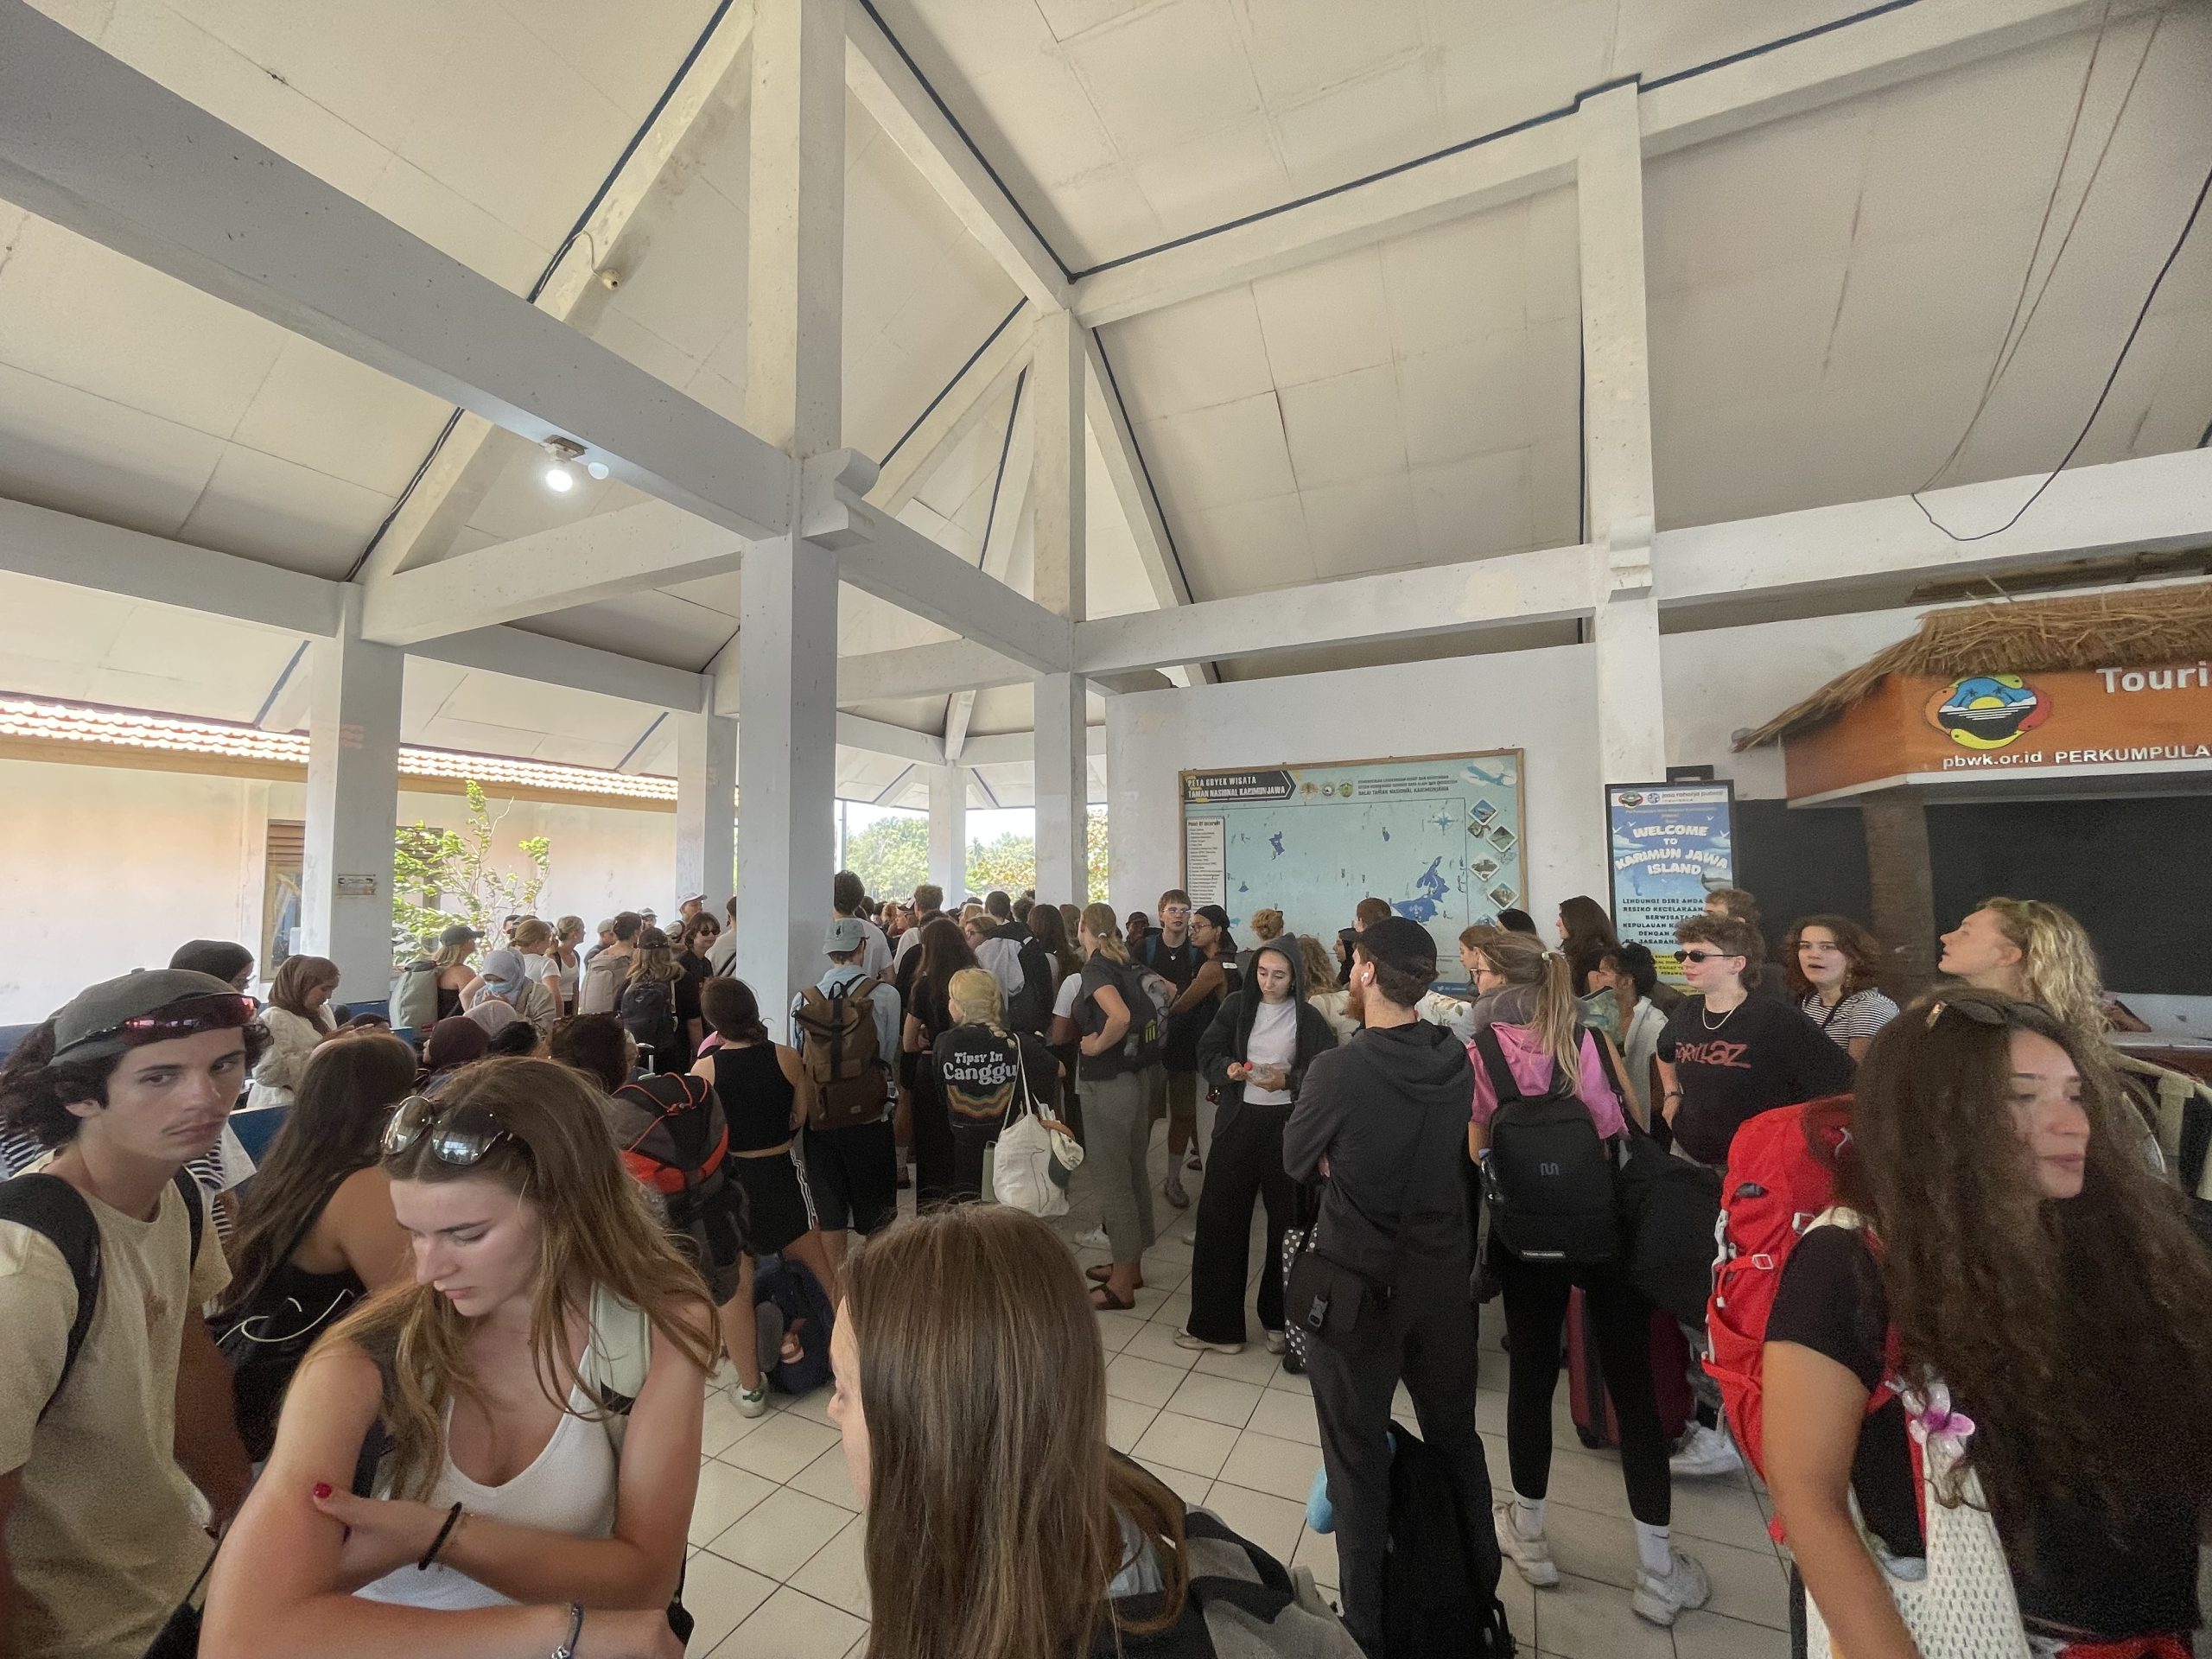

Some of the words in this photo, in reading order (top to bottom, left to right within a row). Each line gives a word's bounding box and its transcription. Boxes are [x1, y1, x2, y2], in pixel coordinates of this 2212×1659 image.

[2095, 660, 2209, 694] Touri
[1943, 751, 2043, 770] pbwk.or.id
[2055, 744, 2211, 764] PERKUMPULA
[1187, 779, 1205, 787] PETA
[1229, 777, 1256, 785] WISATA
[1188, 789, 1209, 798] TAMAN
[1210, 788, 1238, 798] NASIONAL
[1632, 824, 1709, 838] WELCOME
[1614, 848, 1681, 870] KARIMUN
[1685, 849, 1728, 869] JAWA
[1647, 862, 1701, 875] ISLAND
[954, 1052, 987, 1066] Tipsy
[989, 1051, 1003, 1063] In
[943, 1062, 1017, 1085] Canggu
